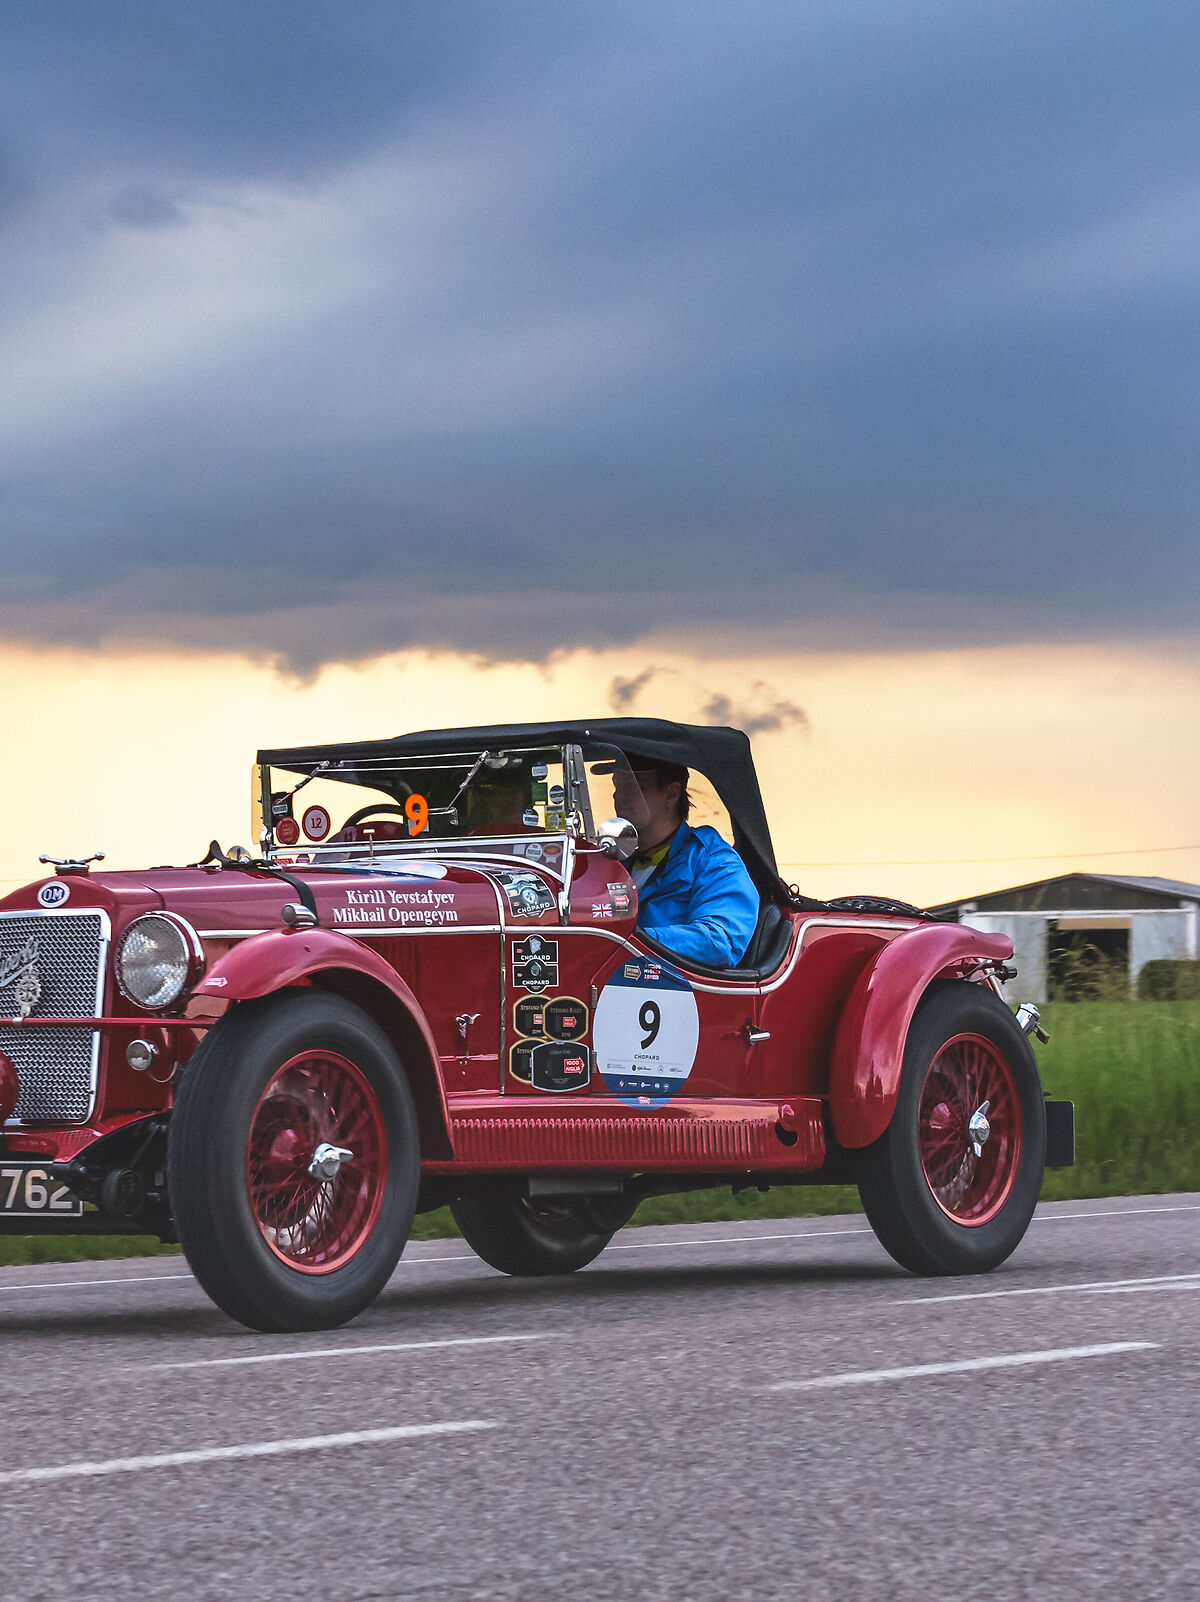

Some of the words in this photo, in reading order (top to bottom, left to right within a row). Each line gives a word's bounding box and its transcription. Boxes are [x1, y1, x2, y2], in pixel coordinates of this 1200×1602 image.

[310, 817, 322, 829] 12
[404, 793, 429, 837] 9
[43, 888, 65, 902] OM
[346, 889, 386, 904] Kirill
[387, 889, 455, 908] Yevstafyev
[332, 907, 386, 923] Mikhail
[388, 907, 458, 925] Opengeym
[517, 902, 550, 914] CHOPARD
[639, 1000, 661, 1050] 9
